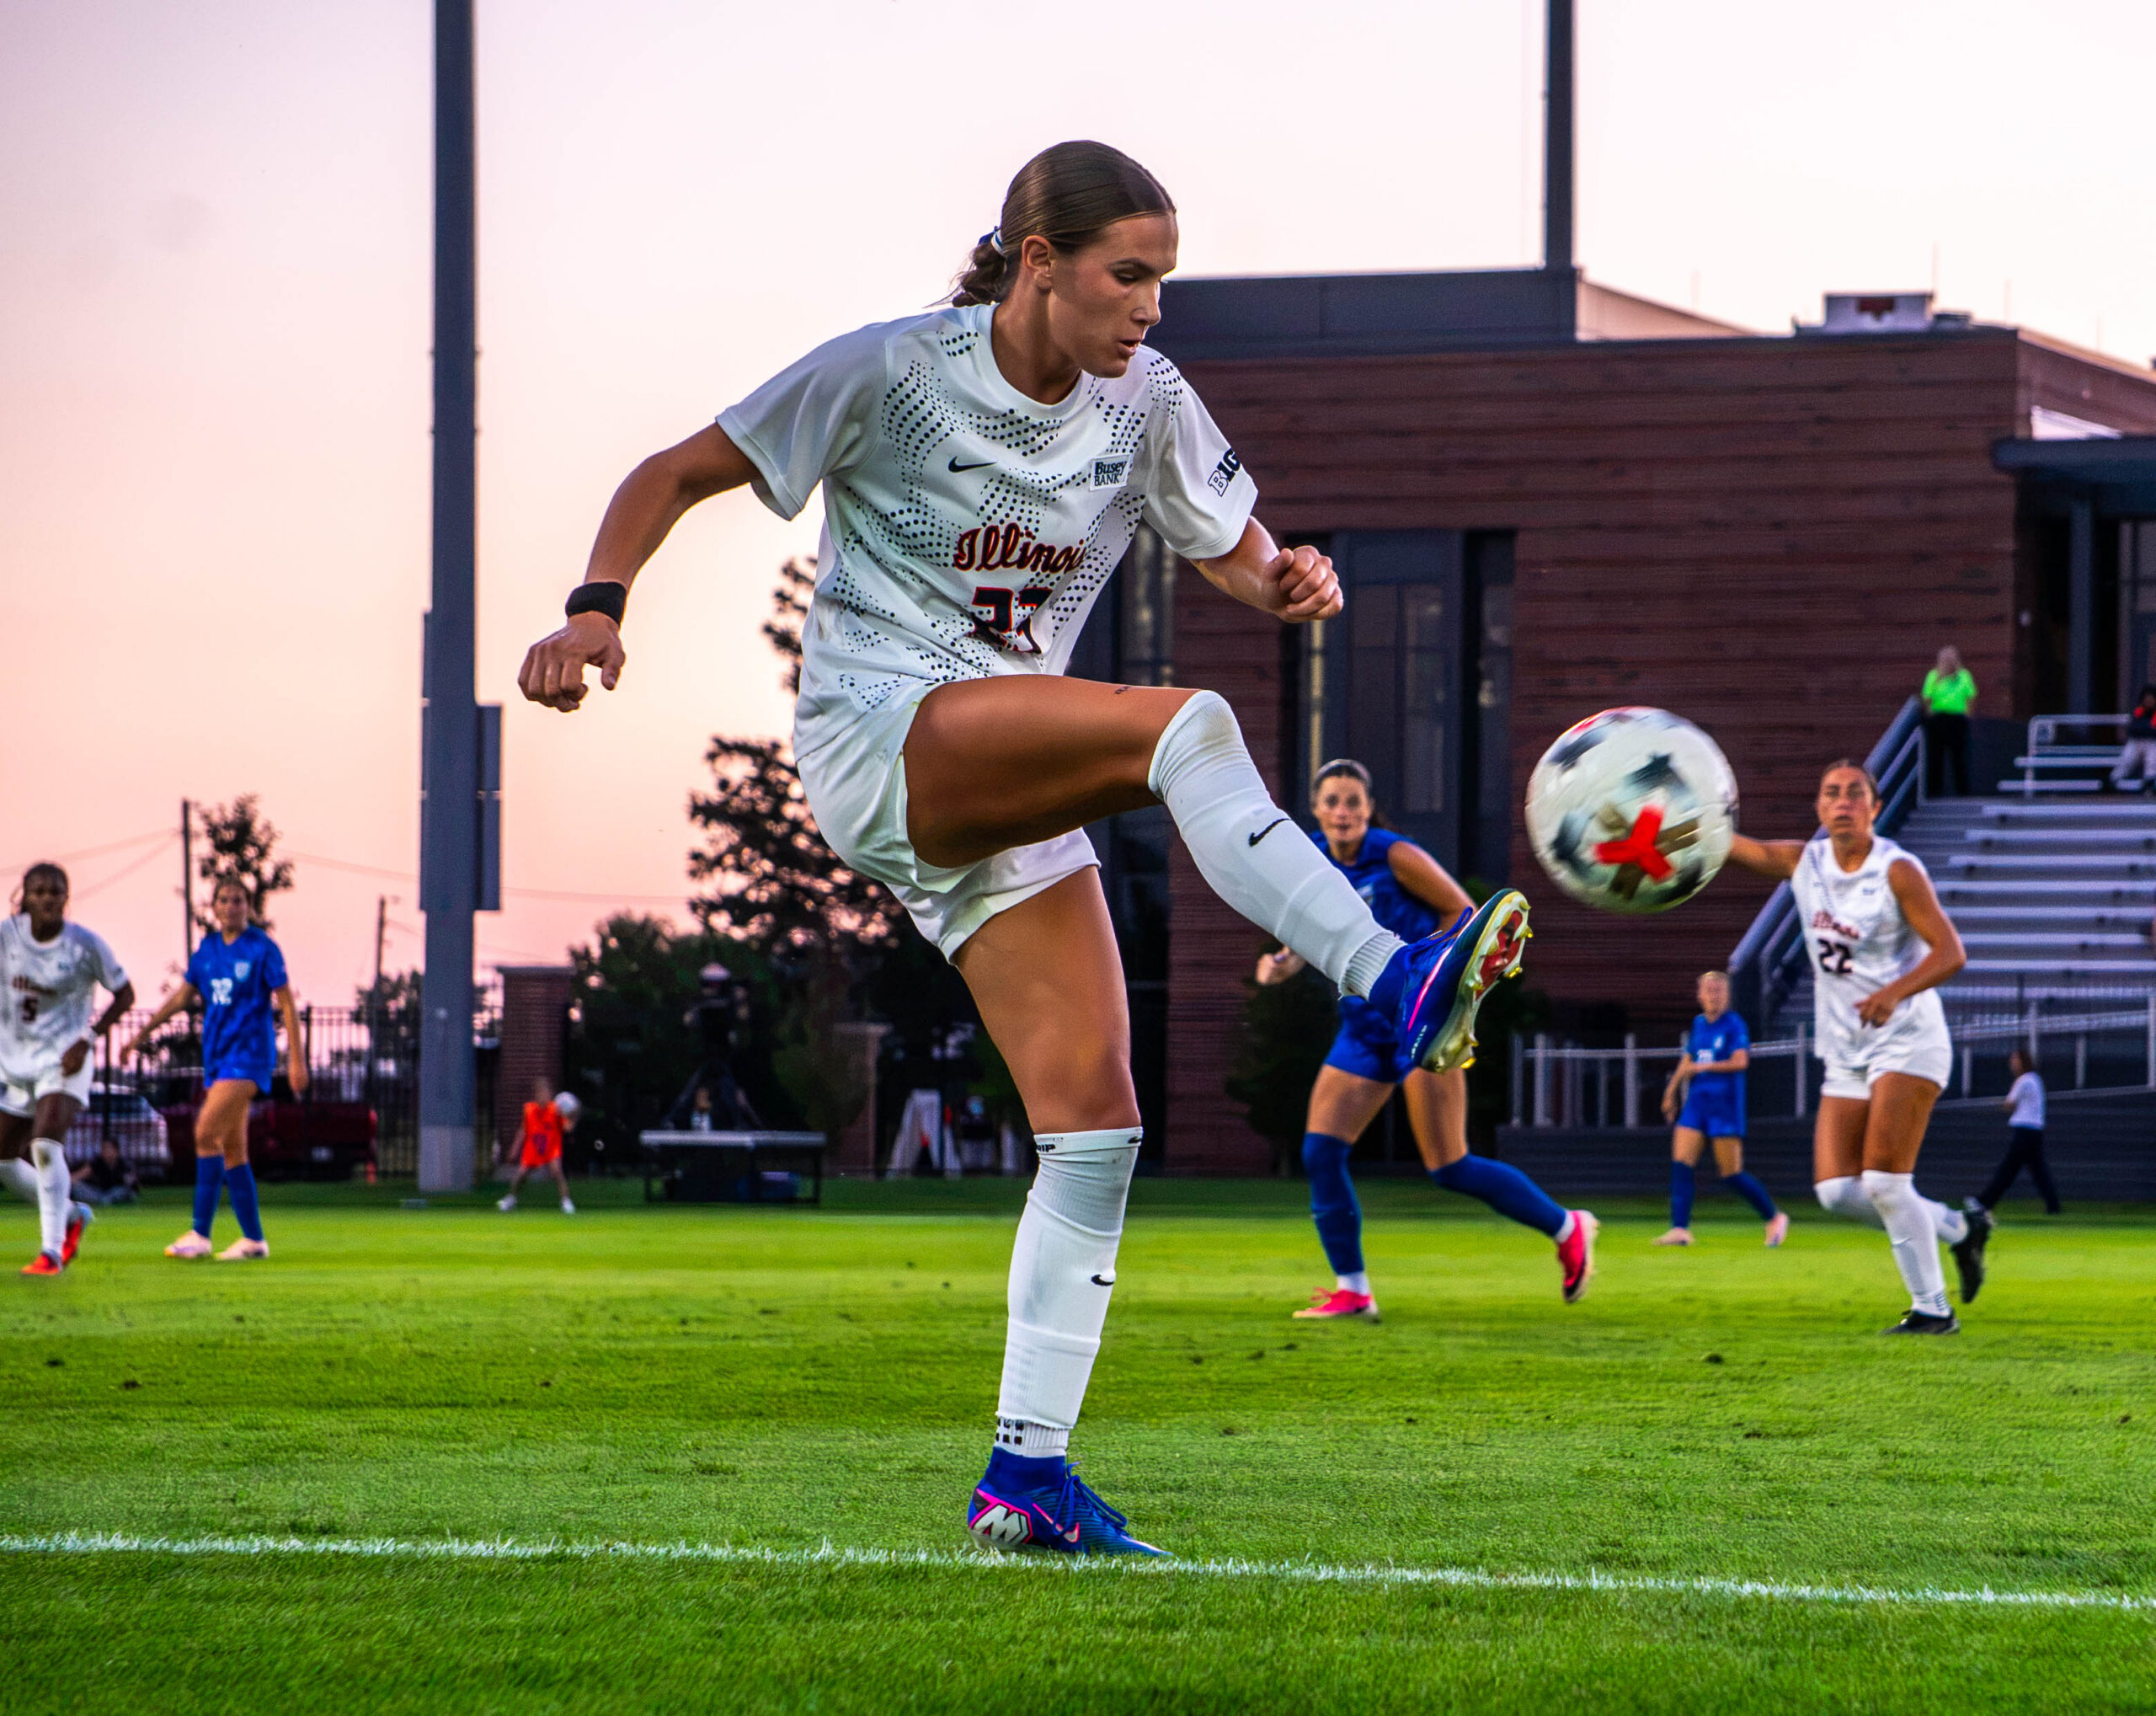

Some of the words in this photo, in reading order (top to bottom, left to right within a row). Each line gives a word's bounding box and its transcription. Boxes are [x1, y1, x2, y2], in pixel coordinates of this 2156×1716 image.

[1095, 461, 1127, 476] Busey
[1094, 473, 1119, 486] BANK
[1817, 938, 1853, 973] 22
[22, 995, 38, 1022] 5
